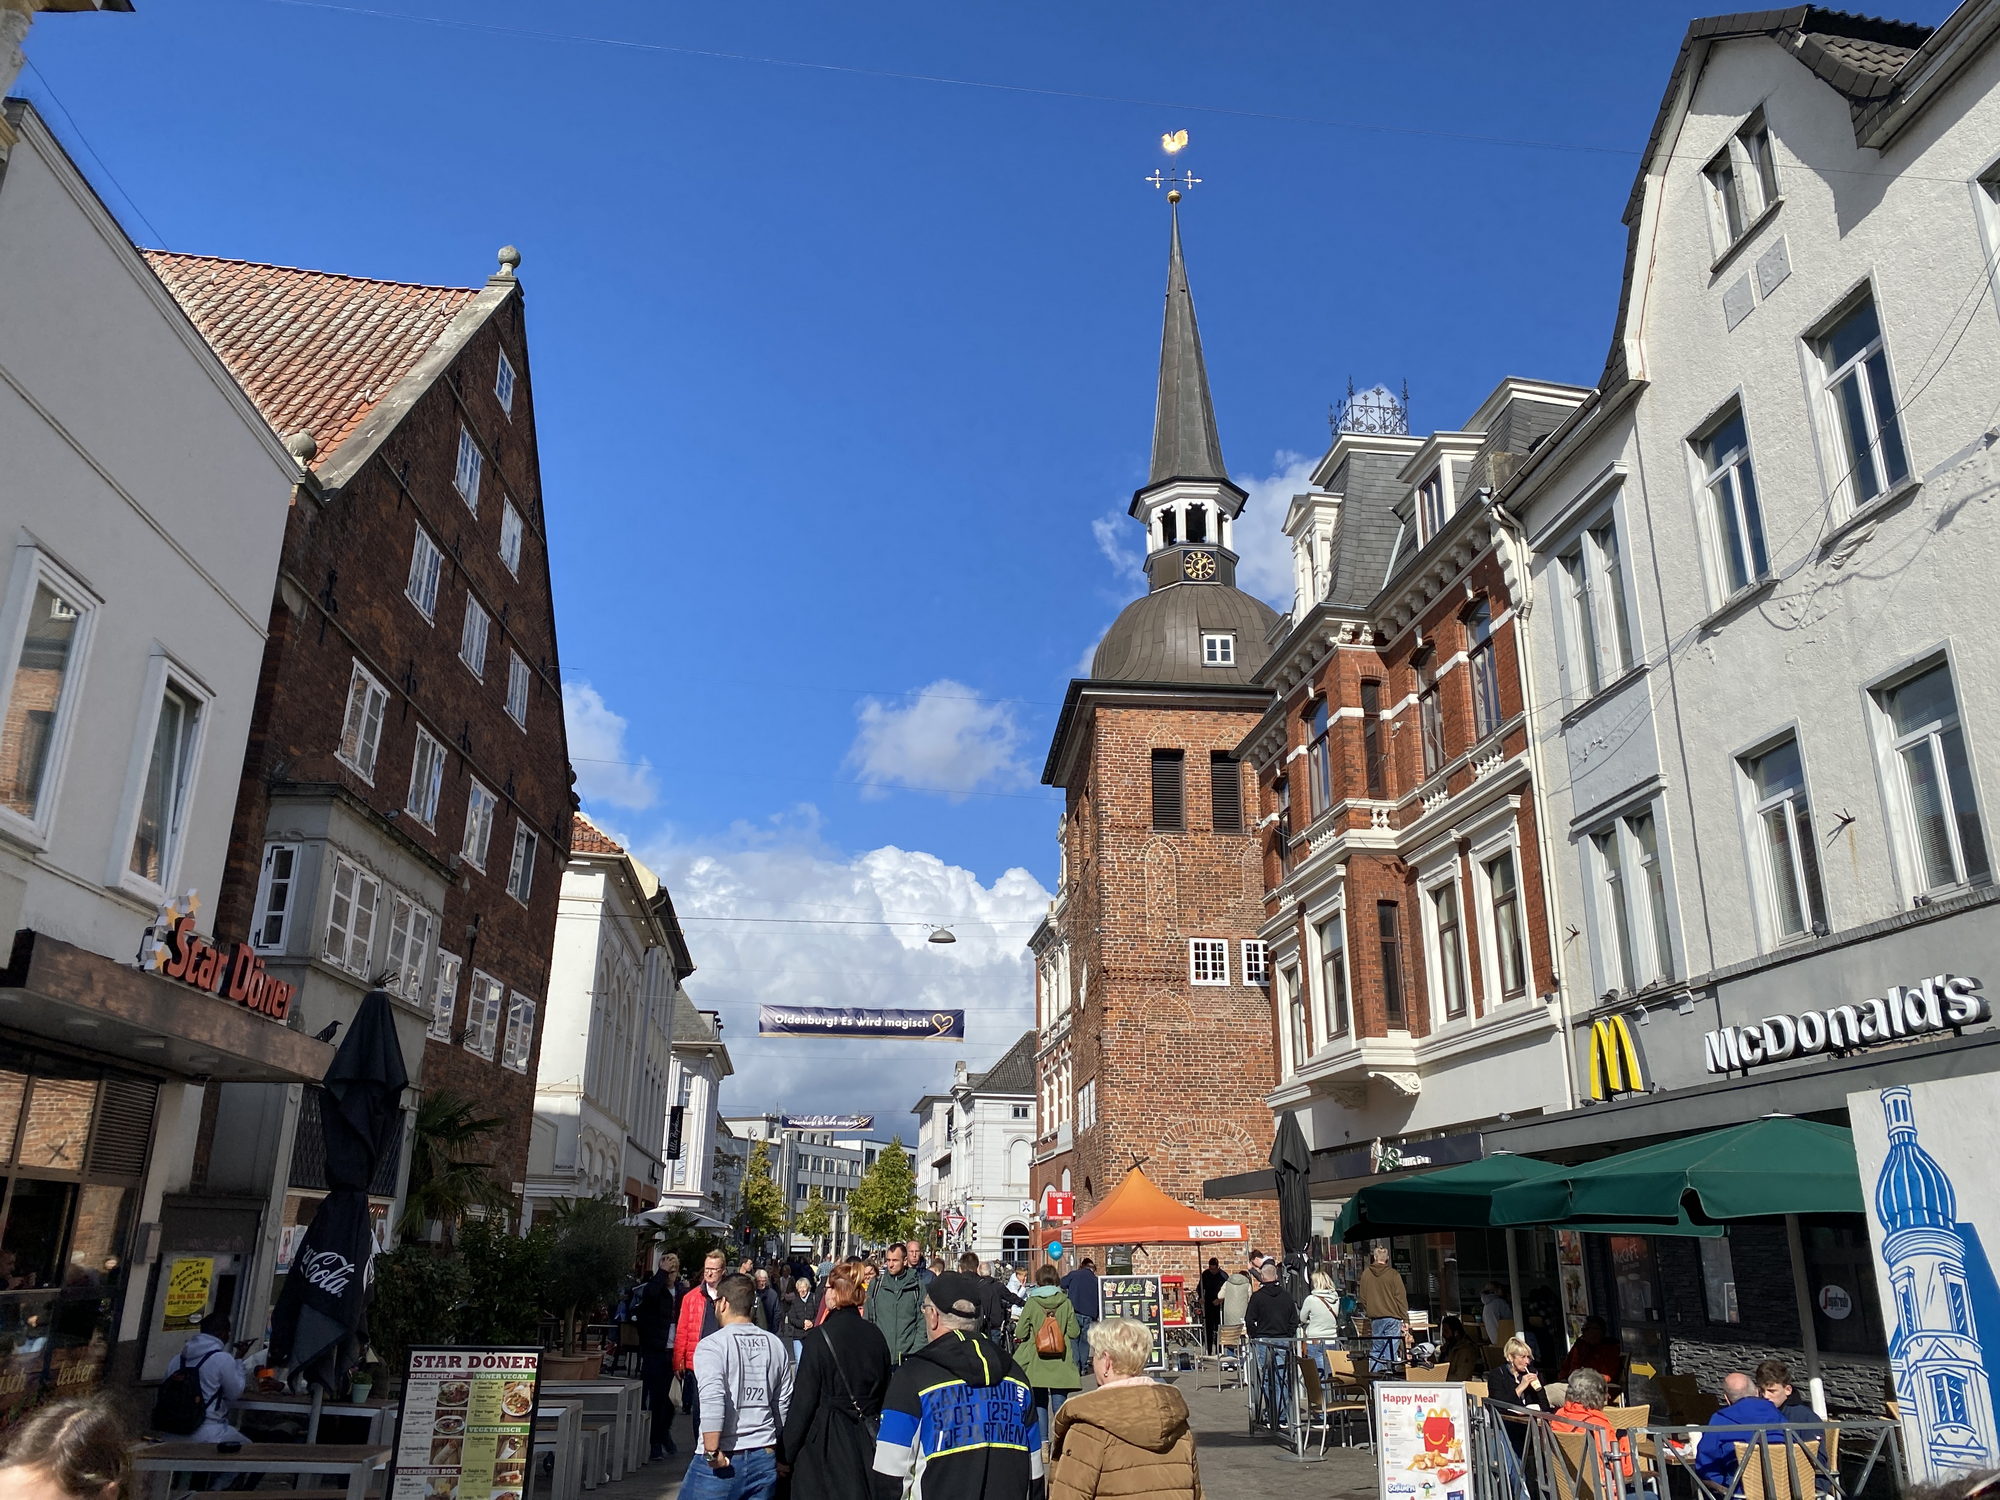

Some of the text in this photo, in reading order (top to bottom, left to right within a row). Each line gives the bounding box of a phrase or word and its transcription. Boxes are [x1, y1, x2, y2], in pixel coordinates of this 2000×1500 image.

[168, 917, 297, 1020] Star Döner
[774, 1013, 930, 1030] Oldenburg! Es wird magisch
[1703, 973, 1990, 1074] McDonald's
[739, 1337, 767, 1347] NIKE
[412, 1352, 538, 1369] STAR DÖNER
[744, 1387, 765, 1401] 1972
[1382, 1393, 1412, 1405] Happy
